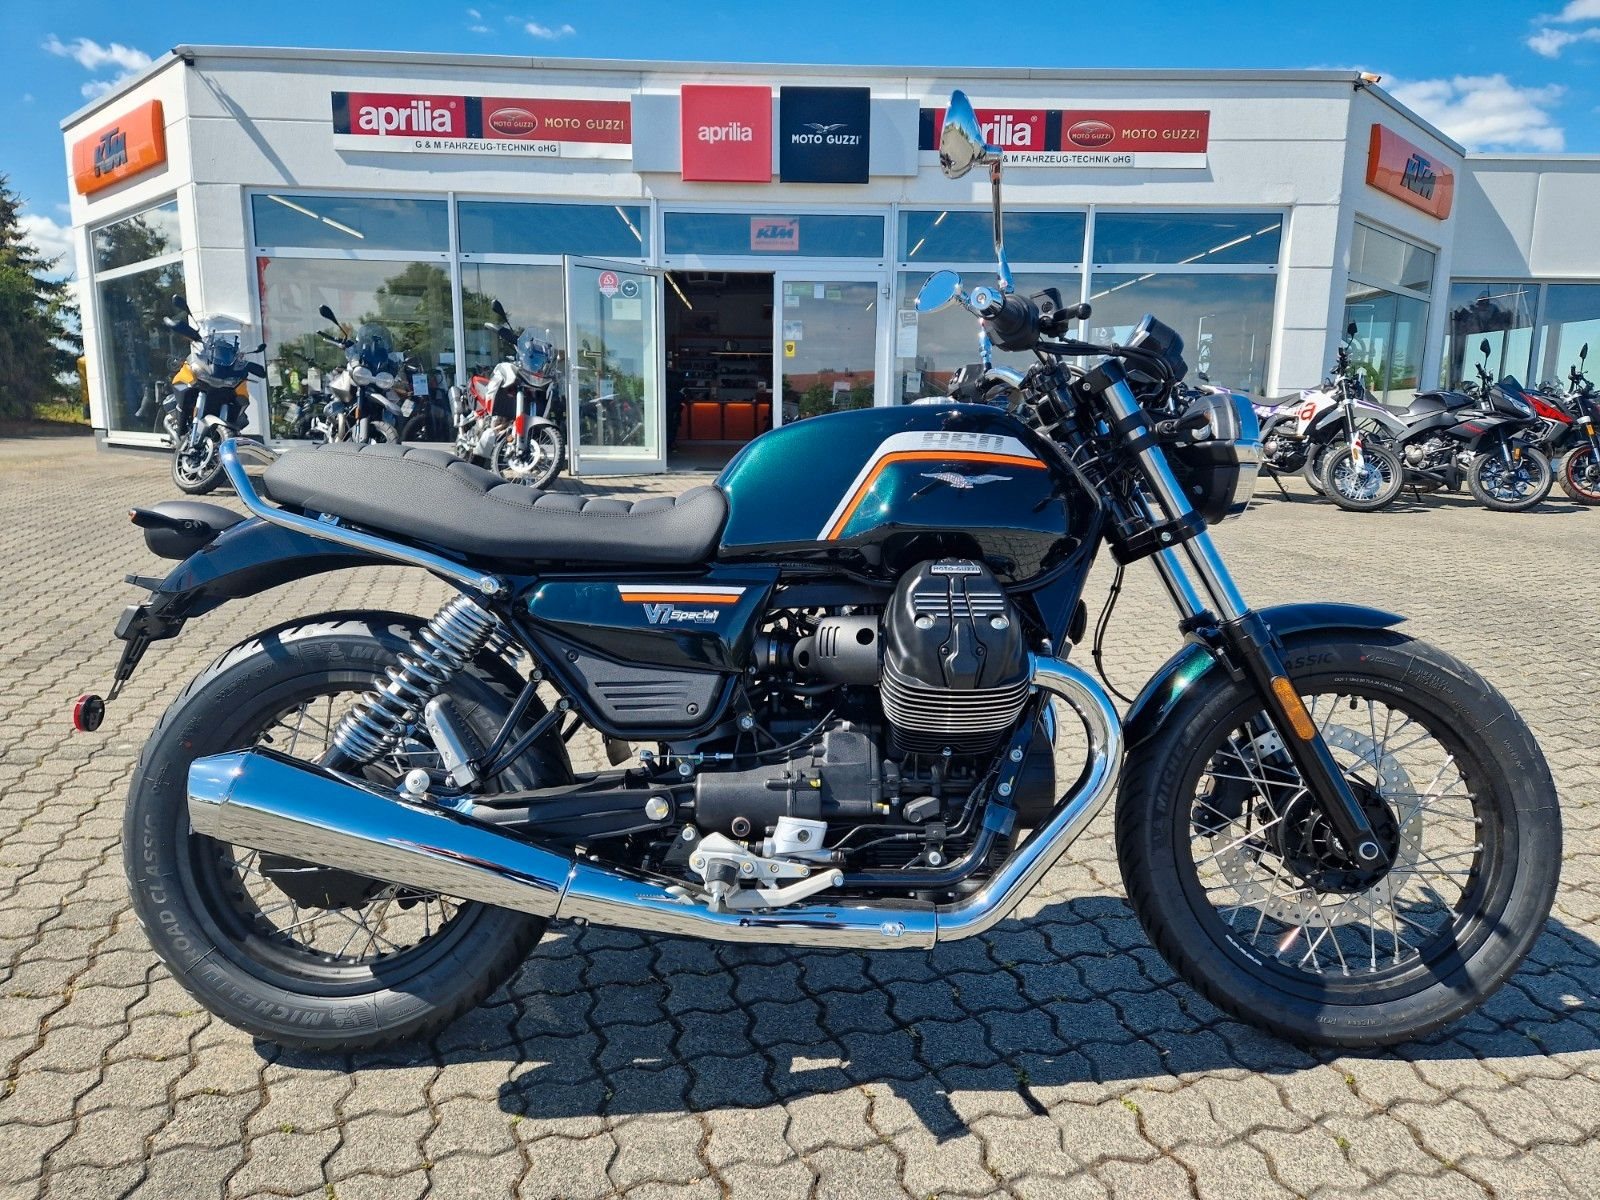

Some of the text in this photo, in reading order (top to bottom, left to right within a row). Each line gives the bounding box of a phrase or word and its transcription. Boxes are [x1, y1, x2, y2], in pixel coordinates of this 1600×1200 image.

[359, 101, 451, 135] aprilia
[544, 118, 624, 131] MOTO GUZZI
[698, 122, 752, 144] aprilia
[981, 114, 1031, 146] rilia
[1122, 129, 1200, 140] MOTO GUZZI
[415, 140, 422, 148] G
[425, 141, 431, 149] &
[434, 141, 441, 149] M
[444, 141, 536, 152] FAHRZEUG-TECHNIK
[792, 134, 859, 145] MOTO GUZZI
[94, 127, 128, 177] KTM
[1021, 155, 1110, 163] FAHRZEUG-TECHNIK
[1113, 155, 1131, 163] oHG
[1400, 153, 1436, 200] KTM
[756, 224, 794, 239] KTM
[643, 603, 720, 624] V7 Special
